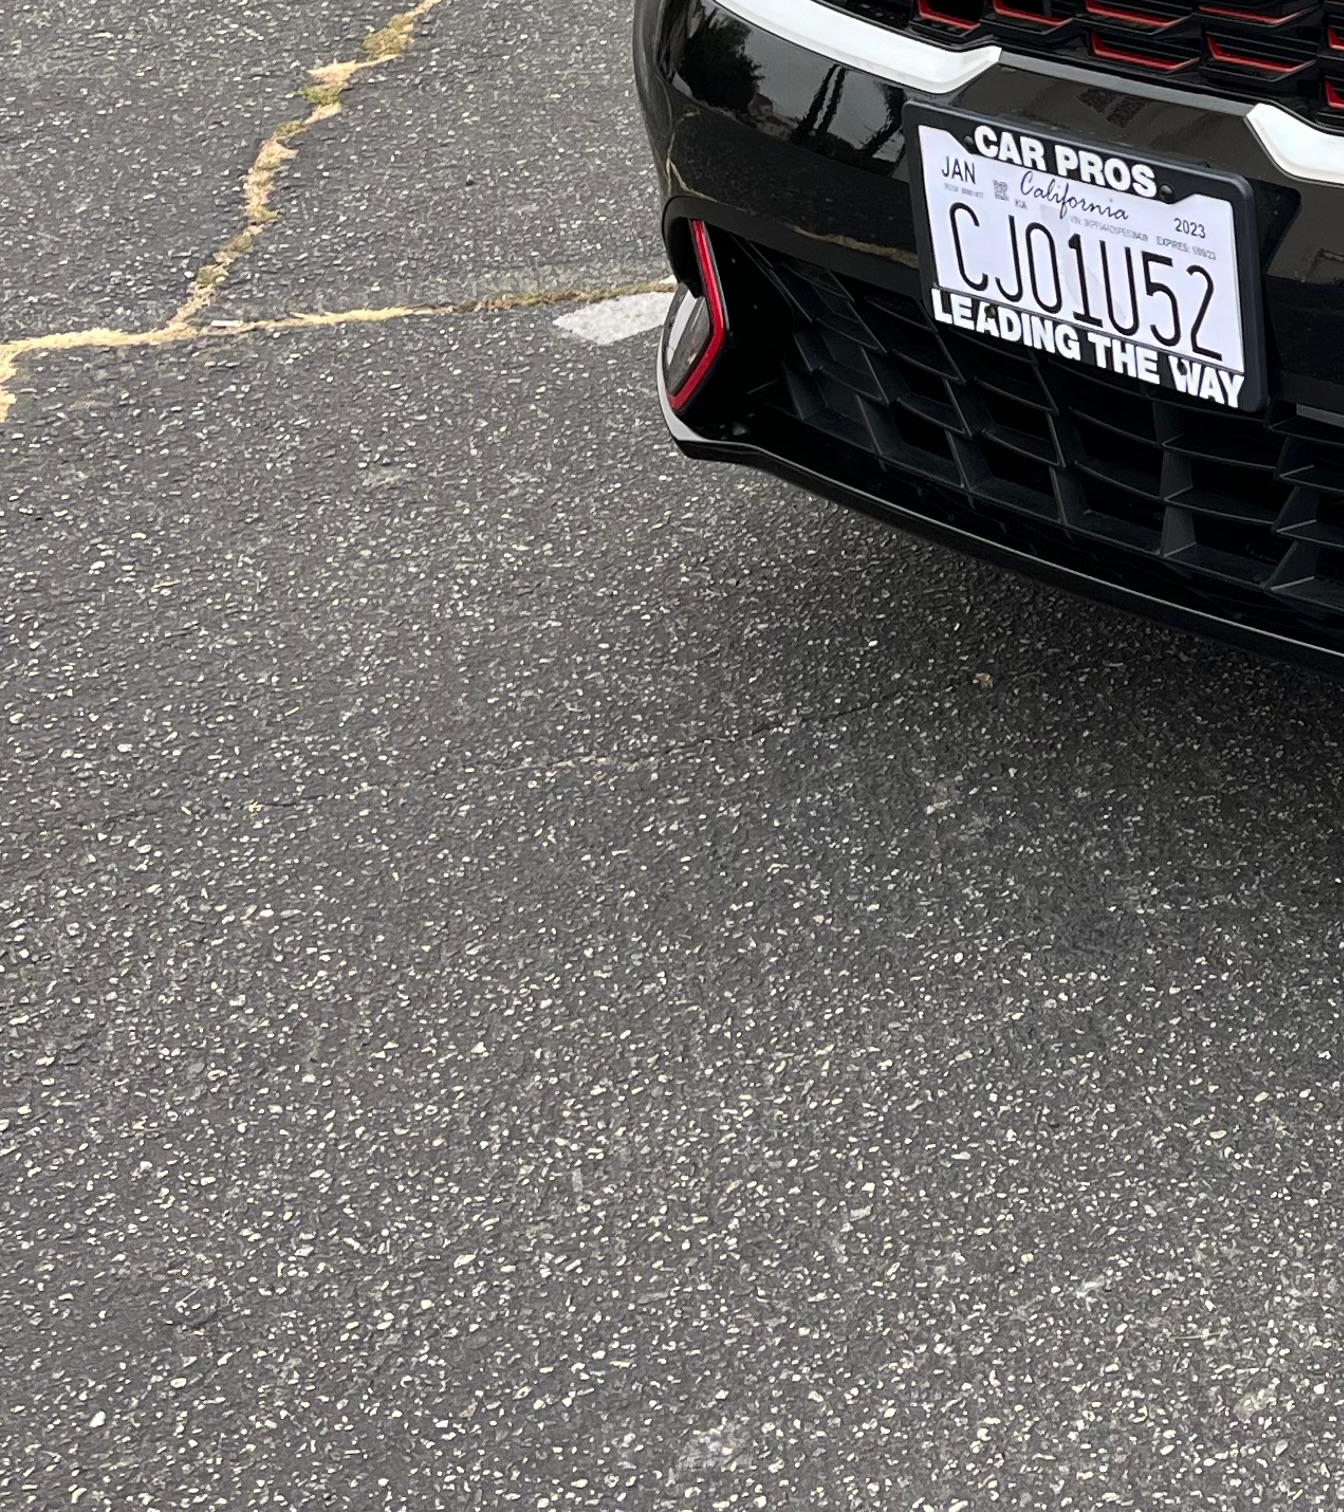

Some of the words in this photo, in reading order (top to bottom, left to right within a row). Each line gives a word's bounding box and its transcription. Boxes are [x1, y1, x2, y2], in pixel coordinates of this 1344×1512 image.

[941, 155, 976, 185] JAN
[974, 125, 1047, 171] CAR
[1054, 144, 1157, 199] PROS
[1020, 170, 1129, 219] California
[1174, 217, 1206, 238] 2023
[948, 202, 1223, 362] CJ01U52
[931, 288, 1082, 362] LEADING
[1087, 333, 1161, 385] THE
[1167, 355, 1245, 409] WAY
